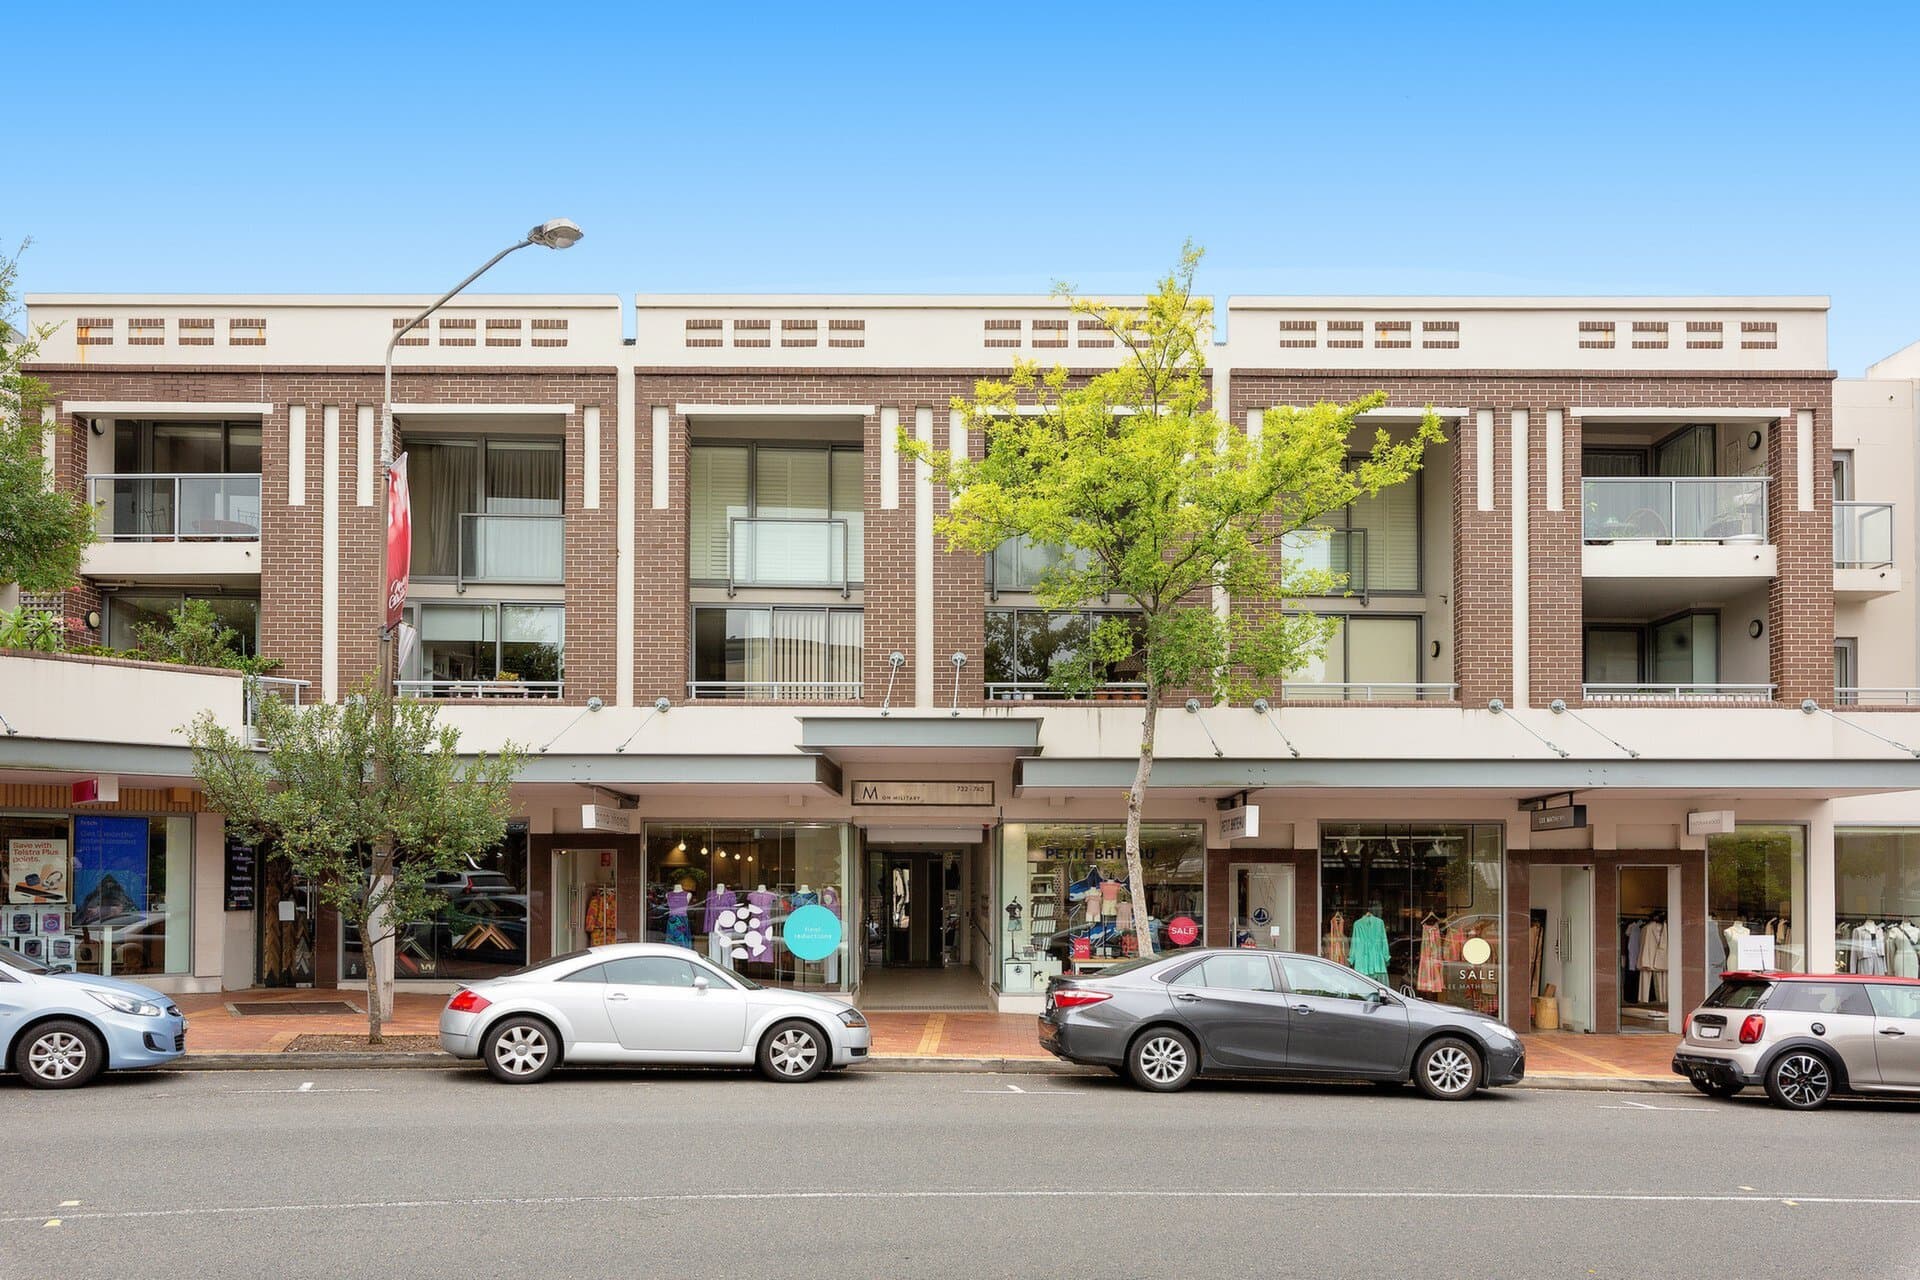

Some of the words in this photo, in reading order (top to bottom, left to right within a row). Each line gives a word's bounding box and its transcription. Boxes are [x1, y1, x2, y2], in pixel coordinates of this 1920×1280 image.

[862, 786, 878, 800] M
[1045, 847, 1087, 860] PETIT
[12, 856, 41, 864] points.
[1171, 927, 1195, 935] SALE
[1459, 969, 1495, 980] SALE
